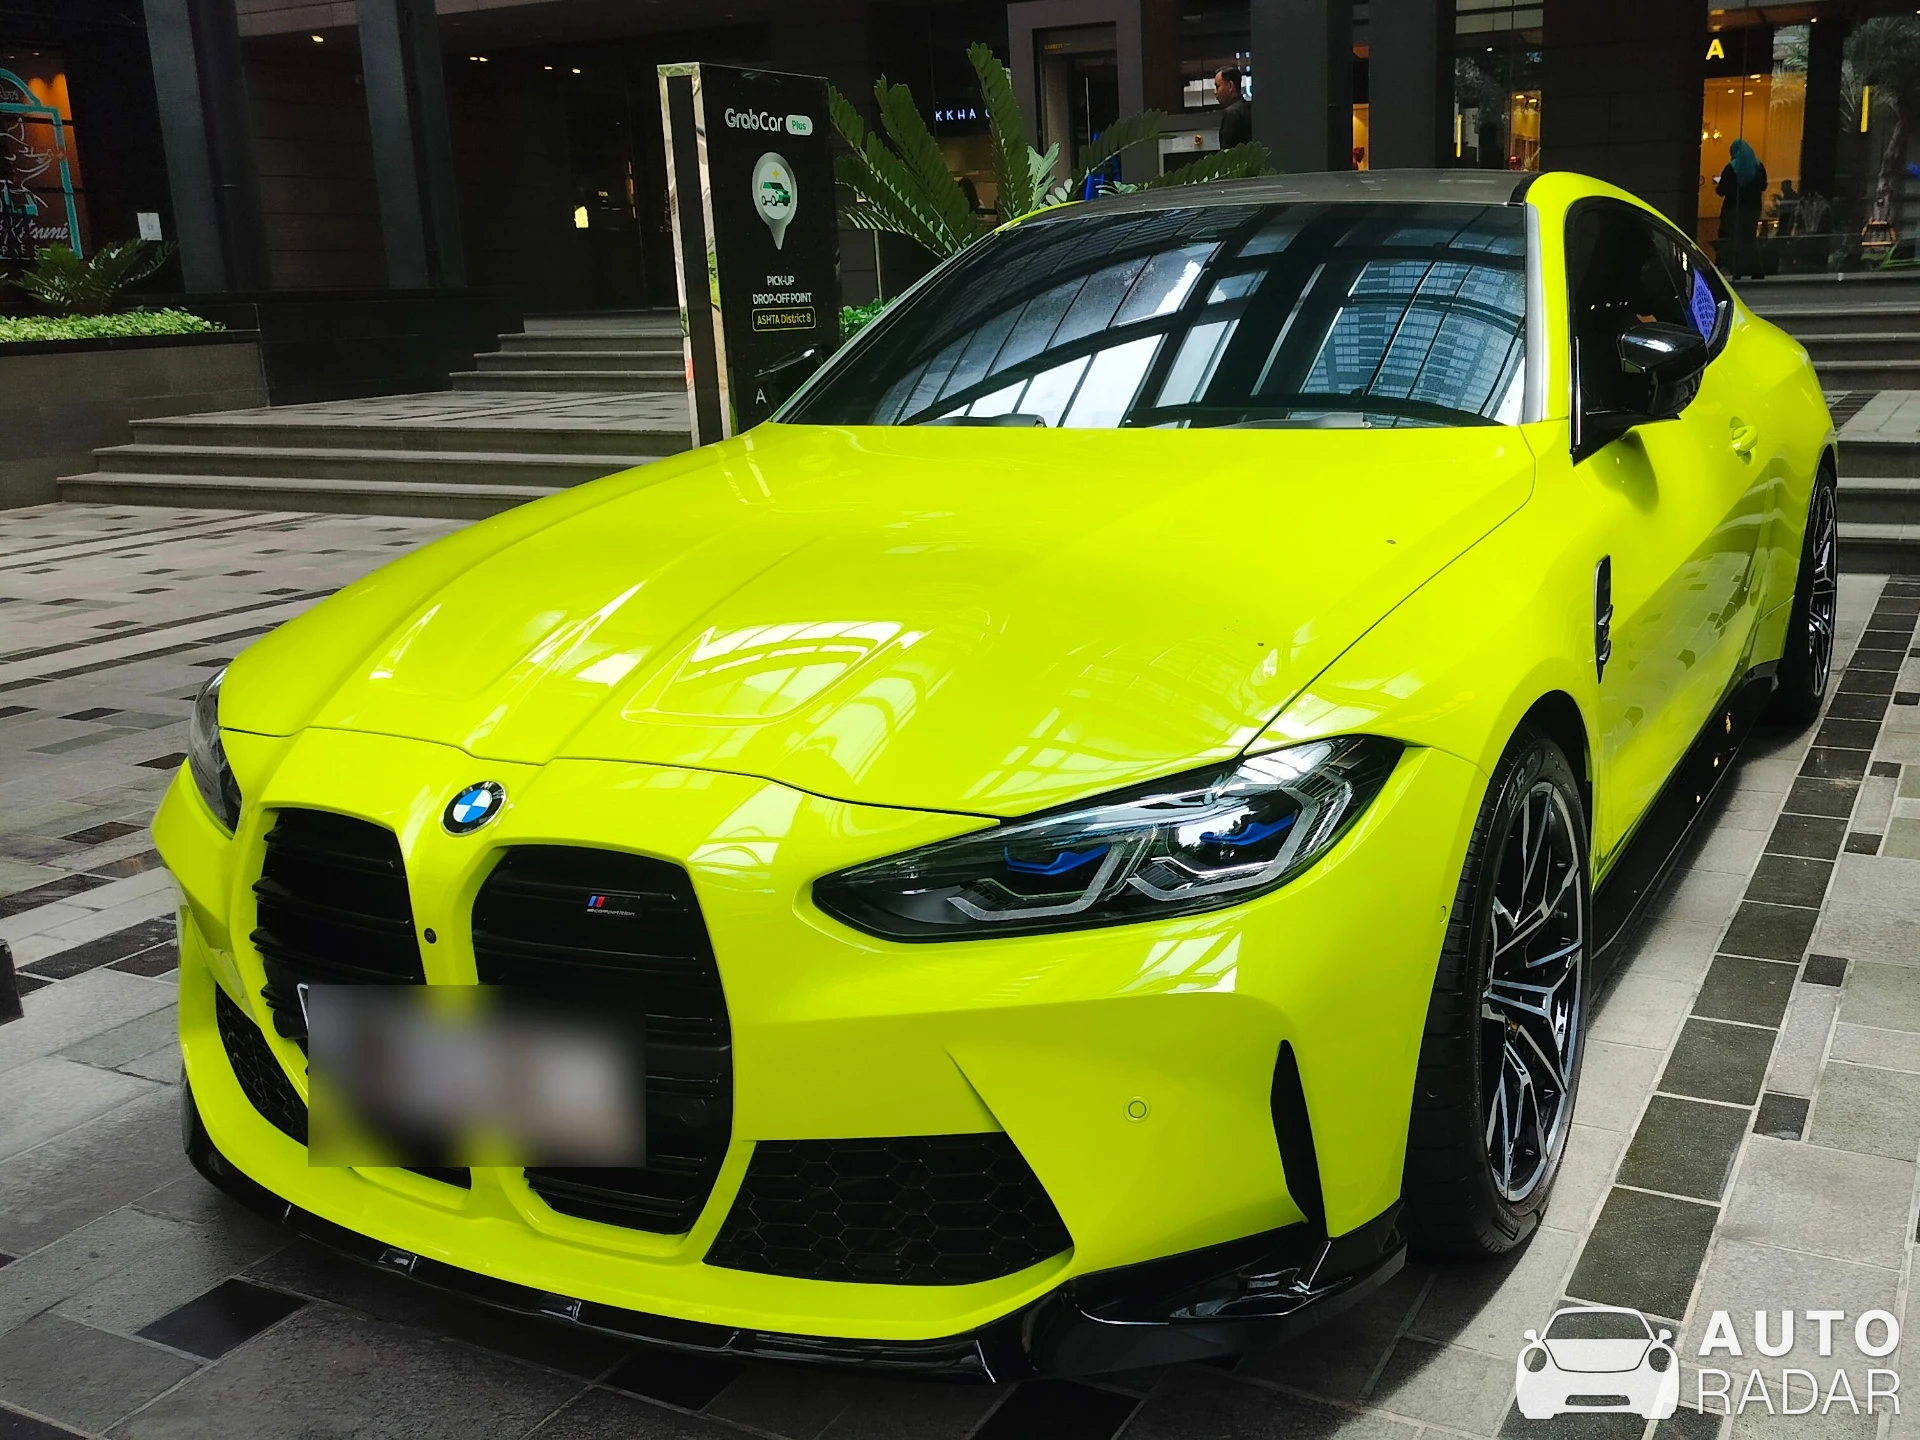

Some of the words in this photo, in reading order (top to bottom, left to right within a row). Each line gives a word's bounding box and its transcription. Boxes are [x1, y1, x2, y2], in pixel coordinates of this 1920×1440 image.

[1706, 38, 1725, 60] A
[725, 107, 783, 132] GrabCar
[792, 120, 807, 131] Plus
[767, 275, 795, 286] PICK-UP
[753, 293, 790, 305] DROP-OFF
[791, 292, 812, 303] POINT
[757, 314, 780, 325] ASHTA
[781, 312, 806, 324] District
[806, 312, 812, 323] 8
[755, 388, 767, 405] A
